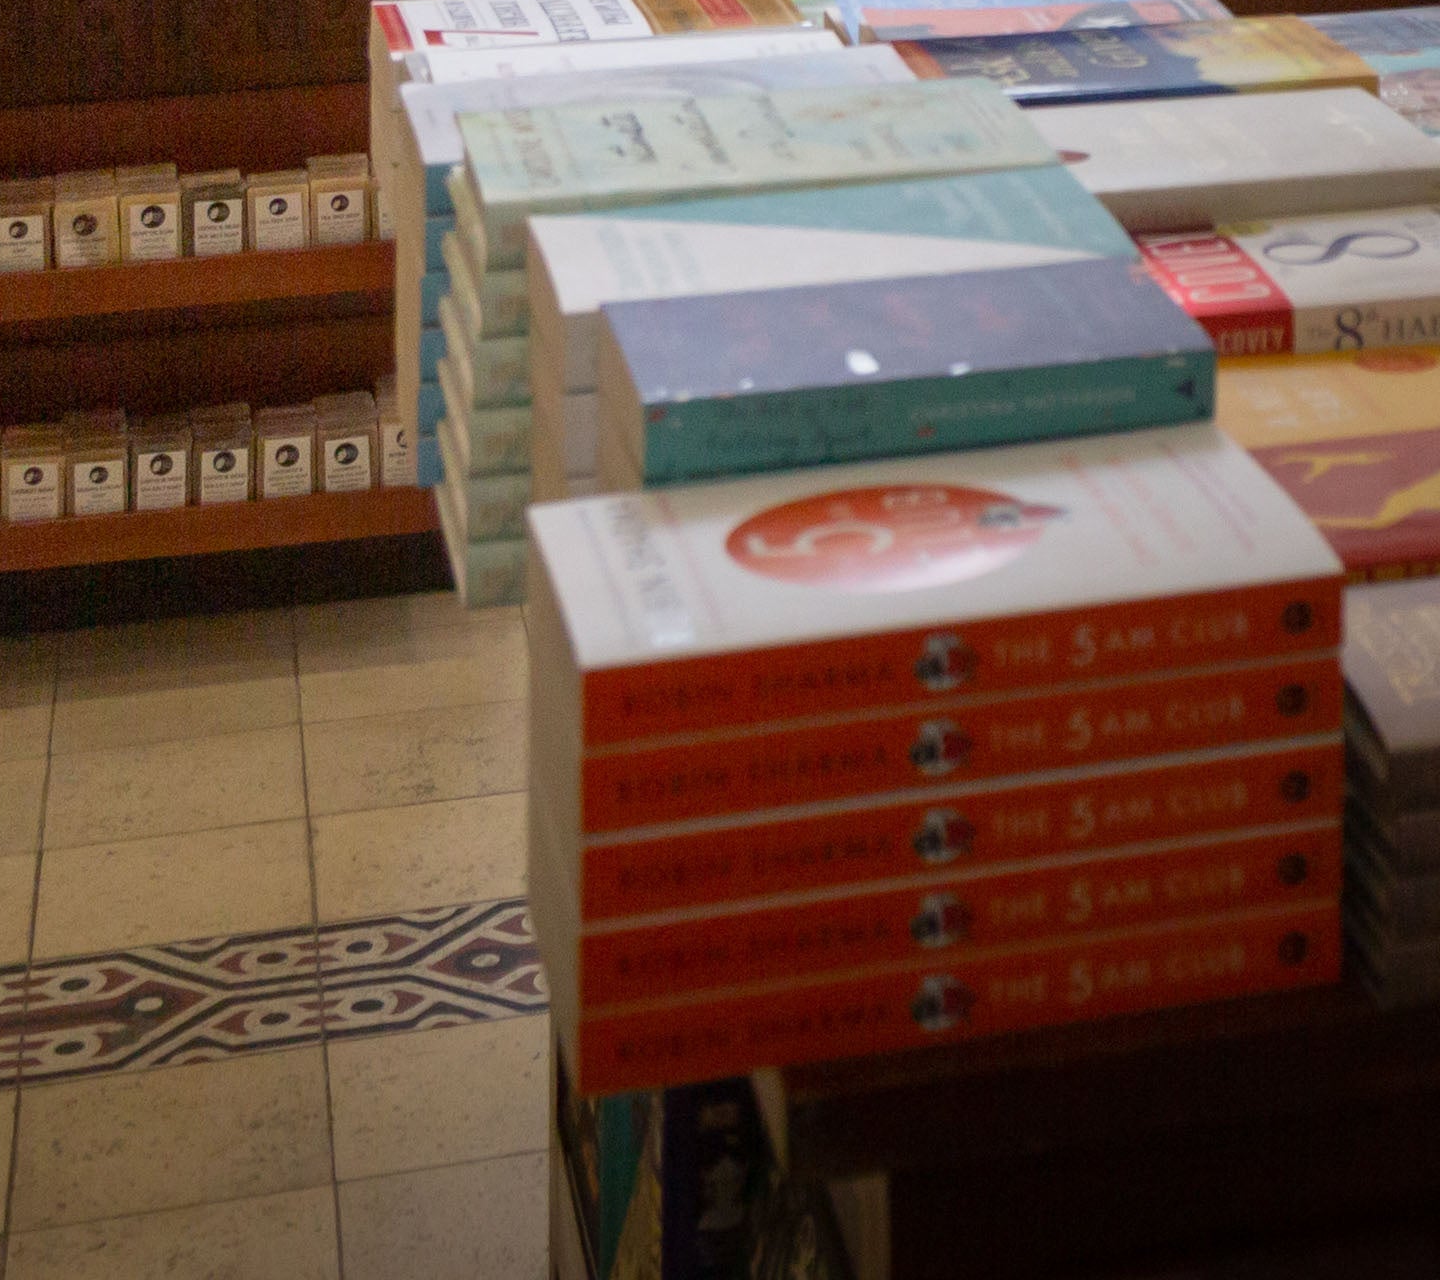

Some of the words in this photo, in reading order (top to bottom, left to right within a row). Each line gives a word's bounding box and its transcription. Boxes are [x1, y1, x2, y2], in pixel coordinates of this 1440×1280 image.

[993, 637, 1051, 668] THE
[1072, 627, 1097, 667] 5
[1104, 627, 1152, 655] AM
[1170, 612, 1249, 645] CLUB
[991, 721, 1047, 754] THE
[1067, 710, 1093, 751] 5
[1101, 709, 1151, 739] AM
[1165, 696, 1245, 730] CLUB
[991, 807, 1051, 840] THE
[1070, 796, 1095, 837] 5
[1104, 795, 1153, 825] AM
[1170, 782, 1248, 816] CLUB
[991, 892, 1049, 924] THE
[1067, 883, 1093, 922] 5
[1101, 881, 1151, 908] AM
[1167, 869, 1245, 901] CLUB
[991, 974, 1047, 1004] THE
[1069, 961, 1094, 1004] 5
[1101, 961, 1151, 988] AM
[1167, 950, 1245, 981] CLUB
